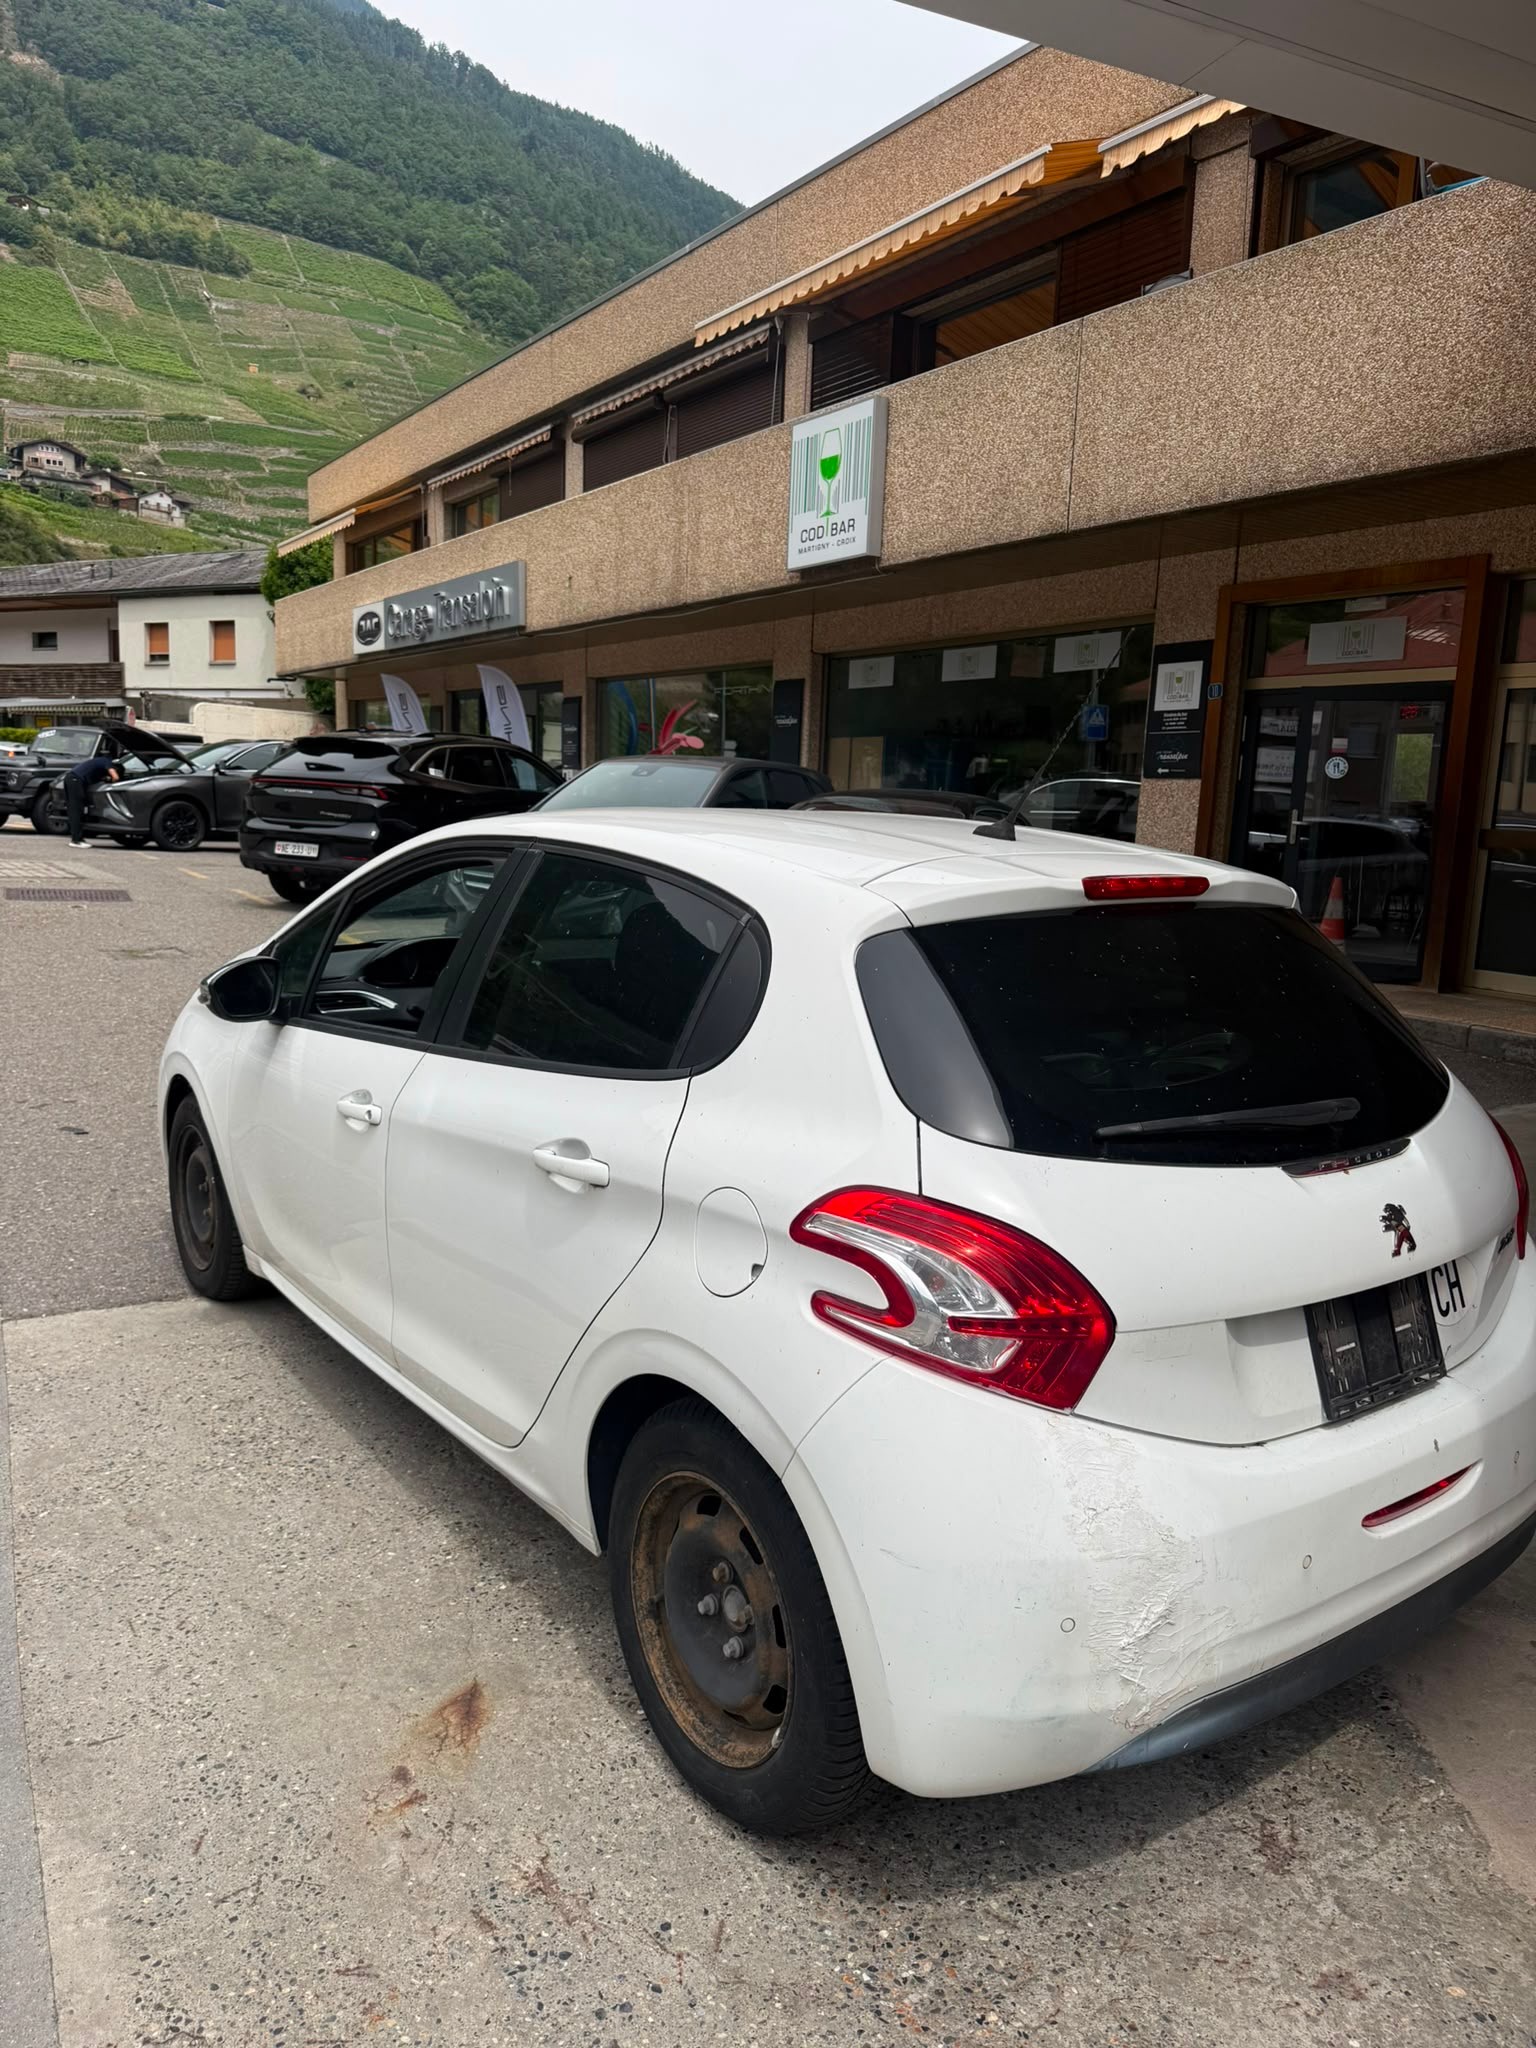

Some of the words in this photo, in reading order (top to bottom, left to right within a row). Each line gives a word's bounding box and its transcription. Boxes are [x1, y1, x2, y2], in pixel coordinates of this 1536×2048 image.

[798, 542, 830, 554] MARTIGNY
[836, 536, 857, 547] CROIX
[359, 616, 380, 631] JAC
[1430, 1259, 1466, 1318] CH
